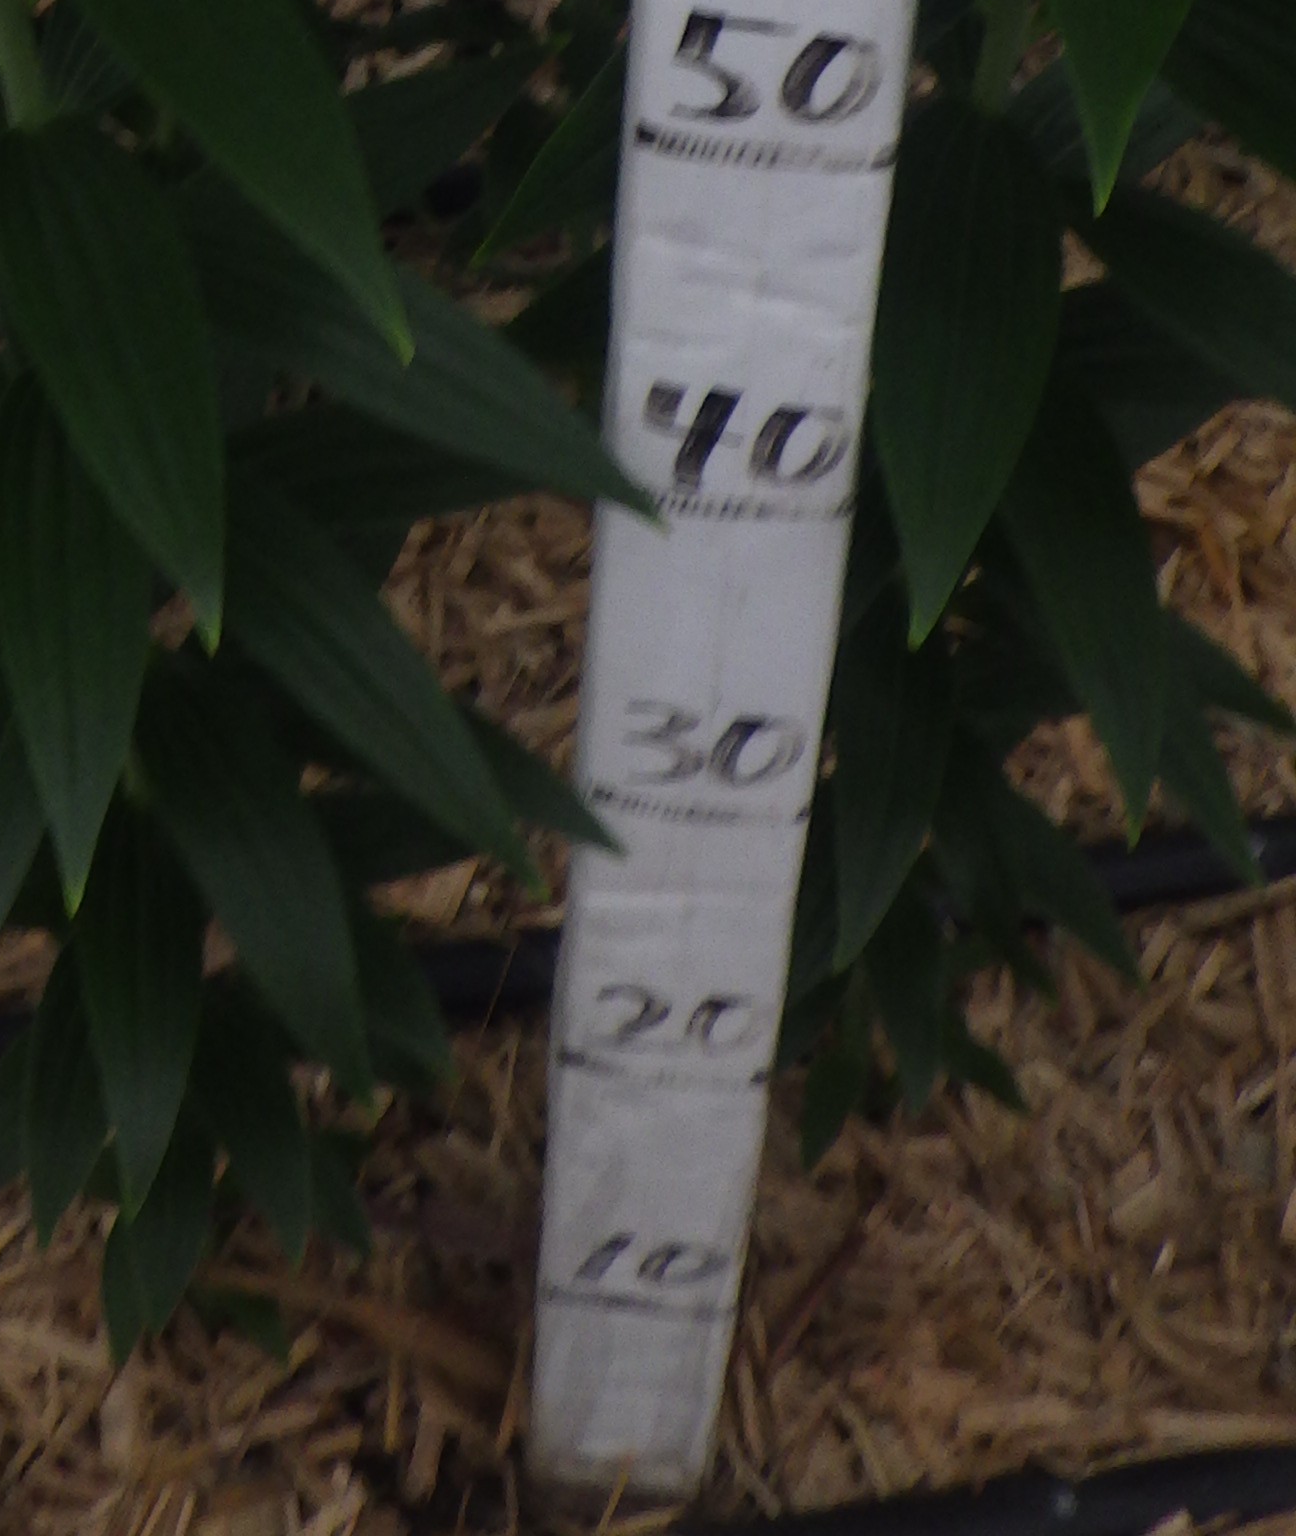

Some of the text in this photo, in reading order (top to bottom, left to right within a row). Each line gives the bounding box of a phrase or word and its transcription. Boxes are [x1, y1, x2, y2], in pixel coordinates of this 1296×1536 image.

[668, 6, 883, 124] 50
[642, 380, 851, 494] 40
[621, 699, 807, 787] 30
[588, 983, 776, 1057] 20
[570, 1230, 731, 1285] 10
